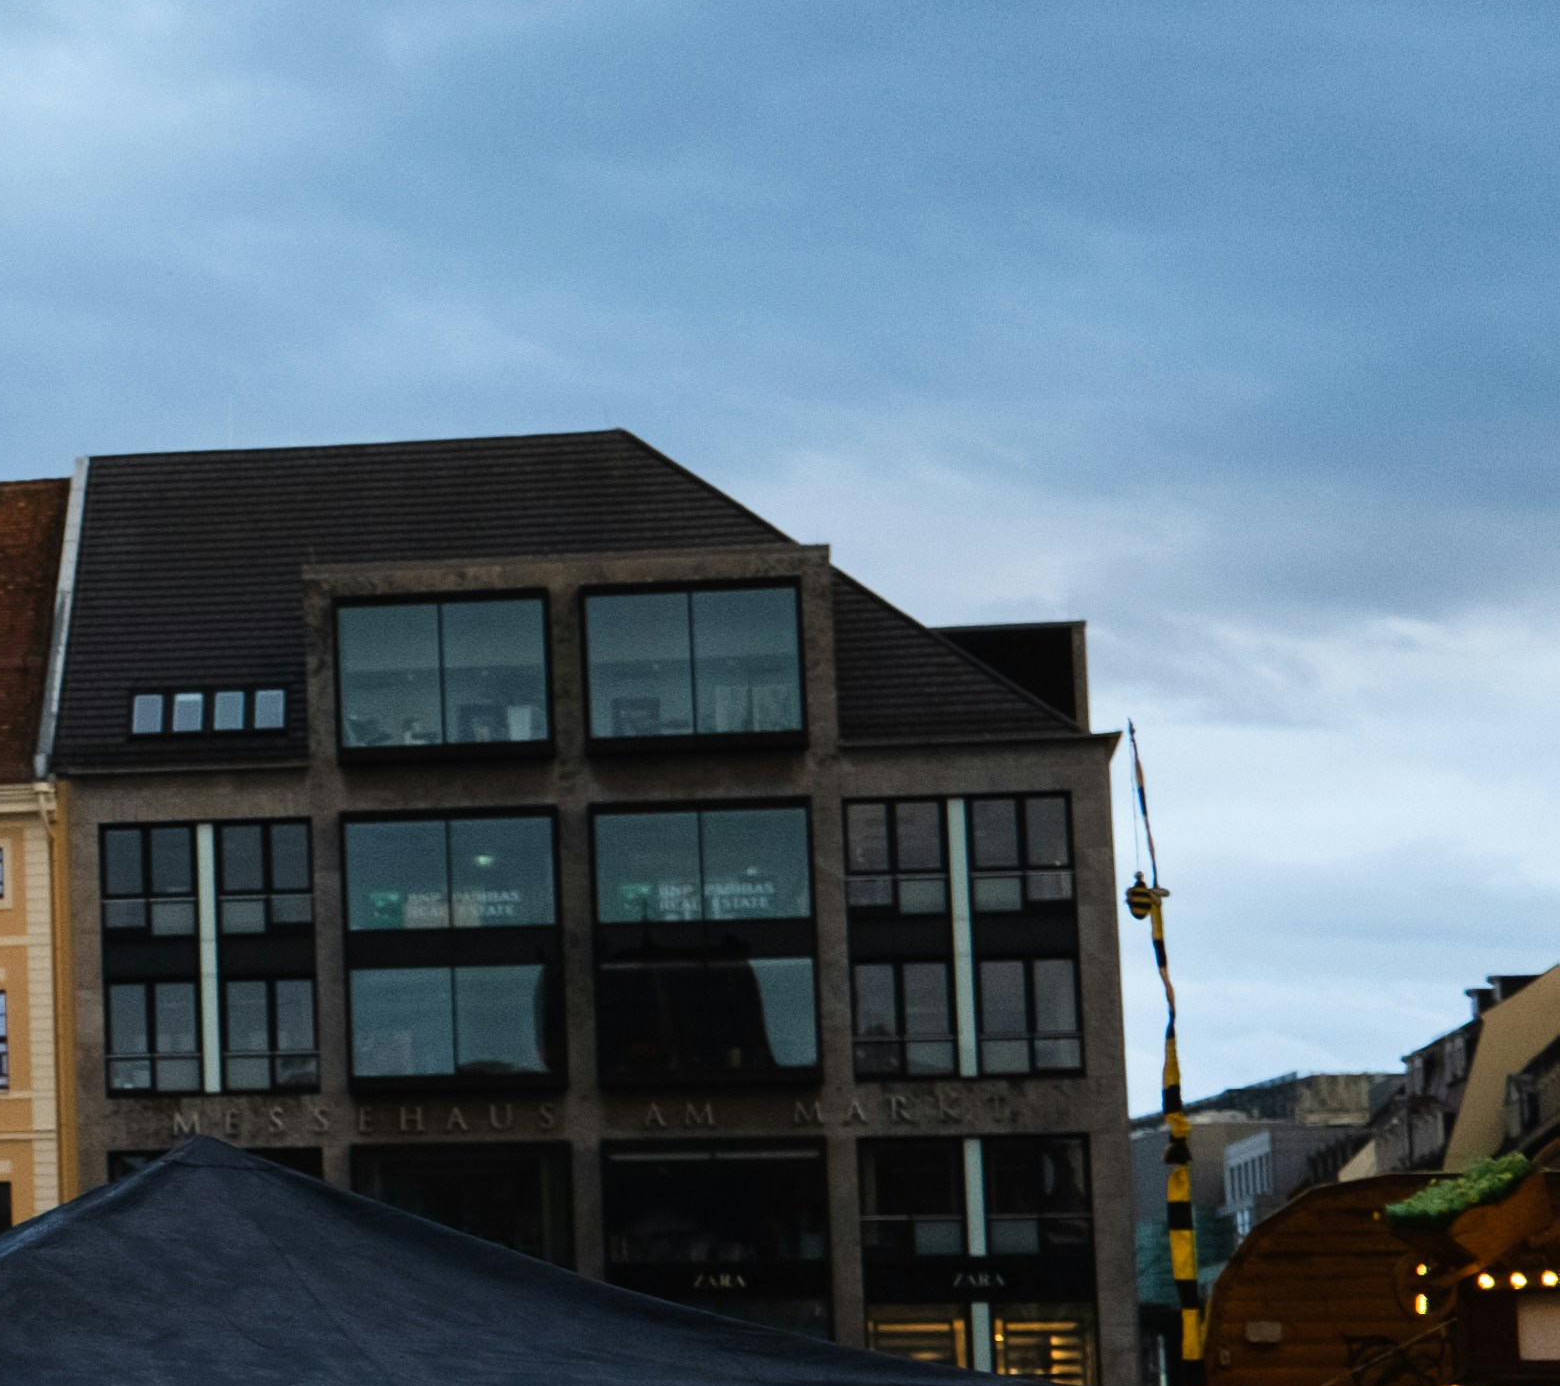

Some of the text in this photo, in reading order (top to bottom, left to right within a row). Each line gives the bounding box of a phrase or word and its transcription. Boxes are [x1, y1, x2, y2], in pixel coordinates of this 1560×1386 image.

[172, 1093, 1024, 1136] MESSEHAUS AM MARKT
[692, 1269, 748, 1290] ZARA
[951, 1269, 1008, 1290] ZARA
